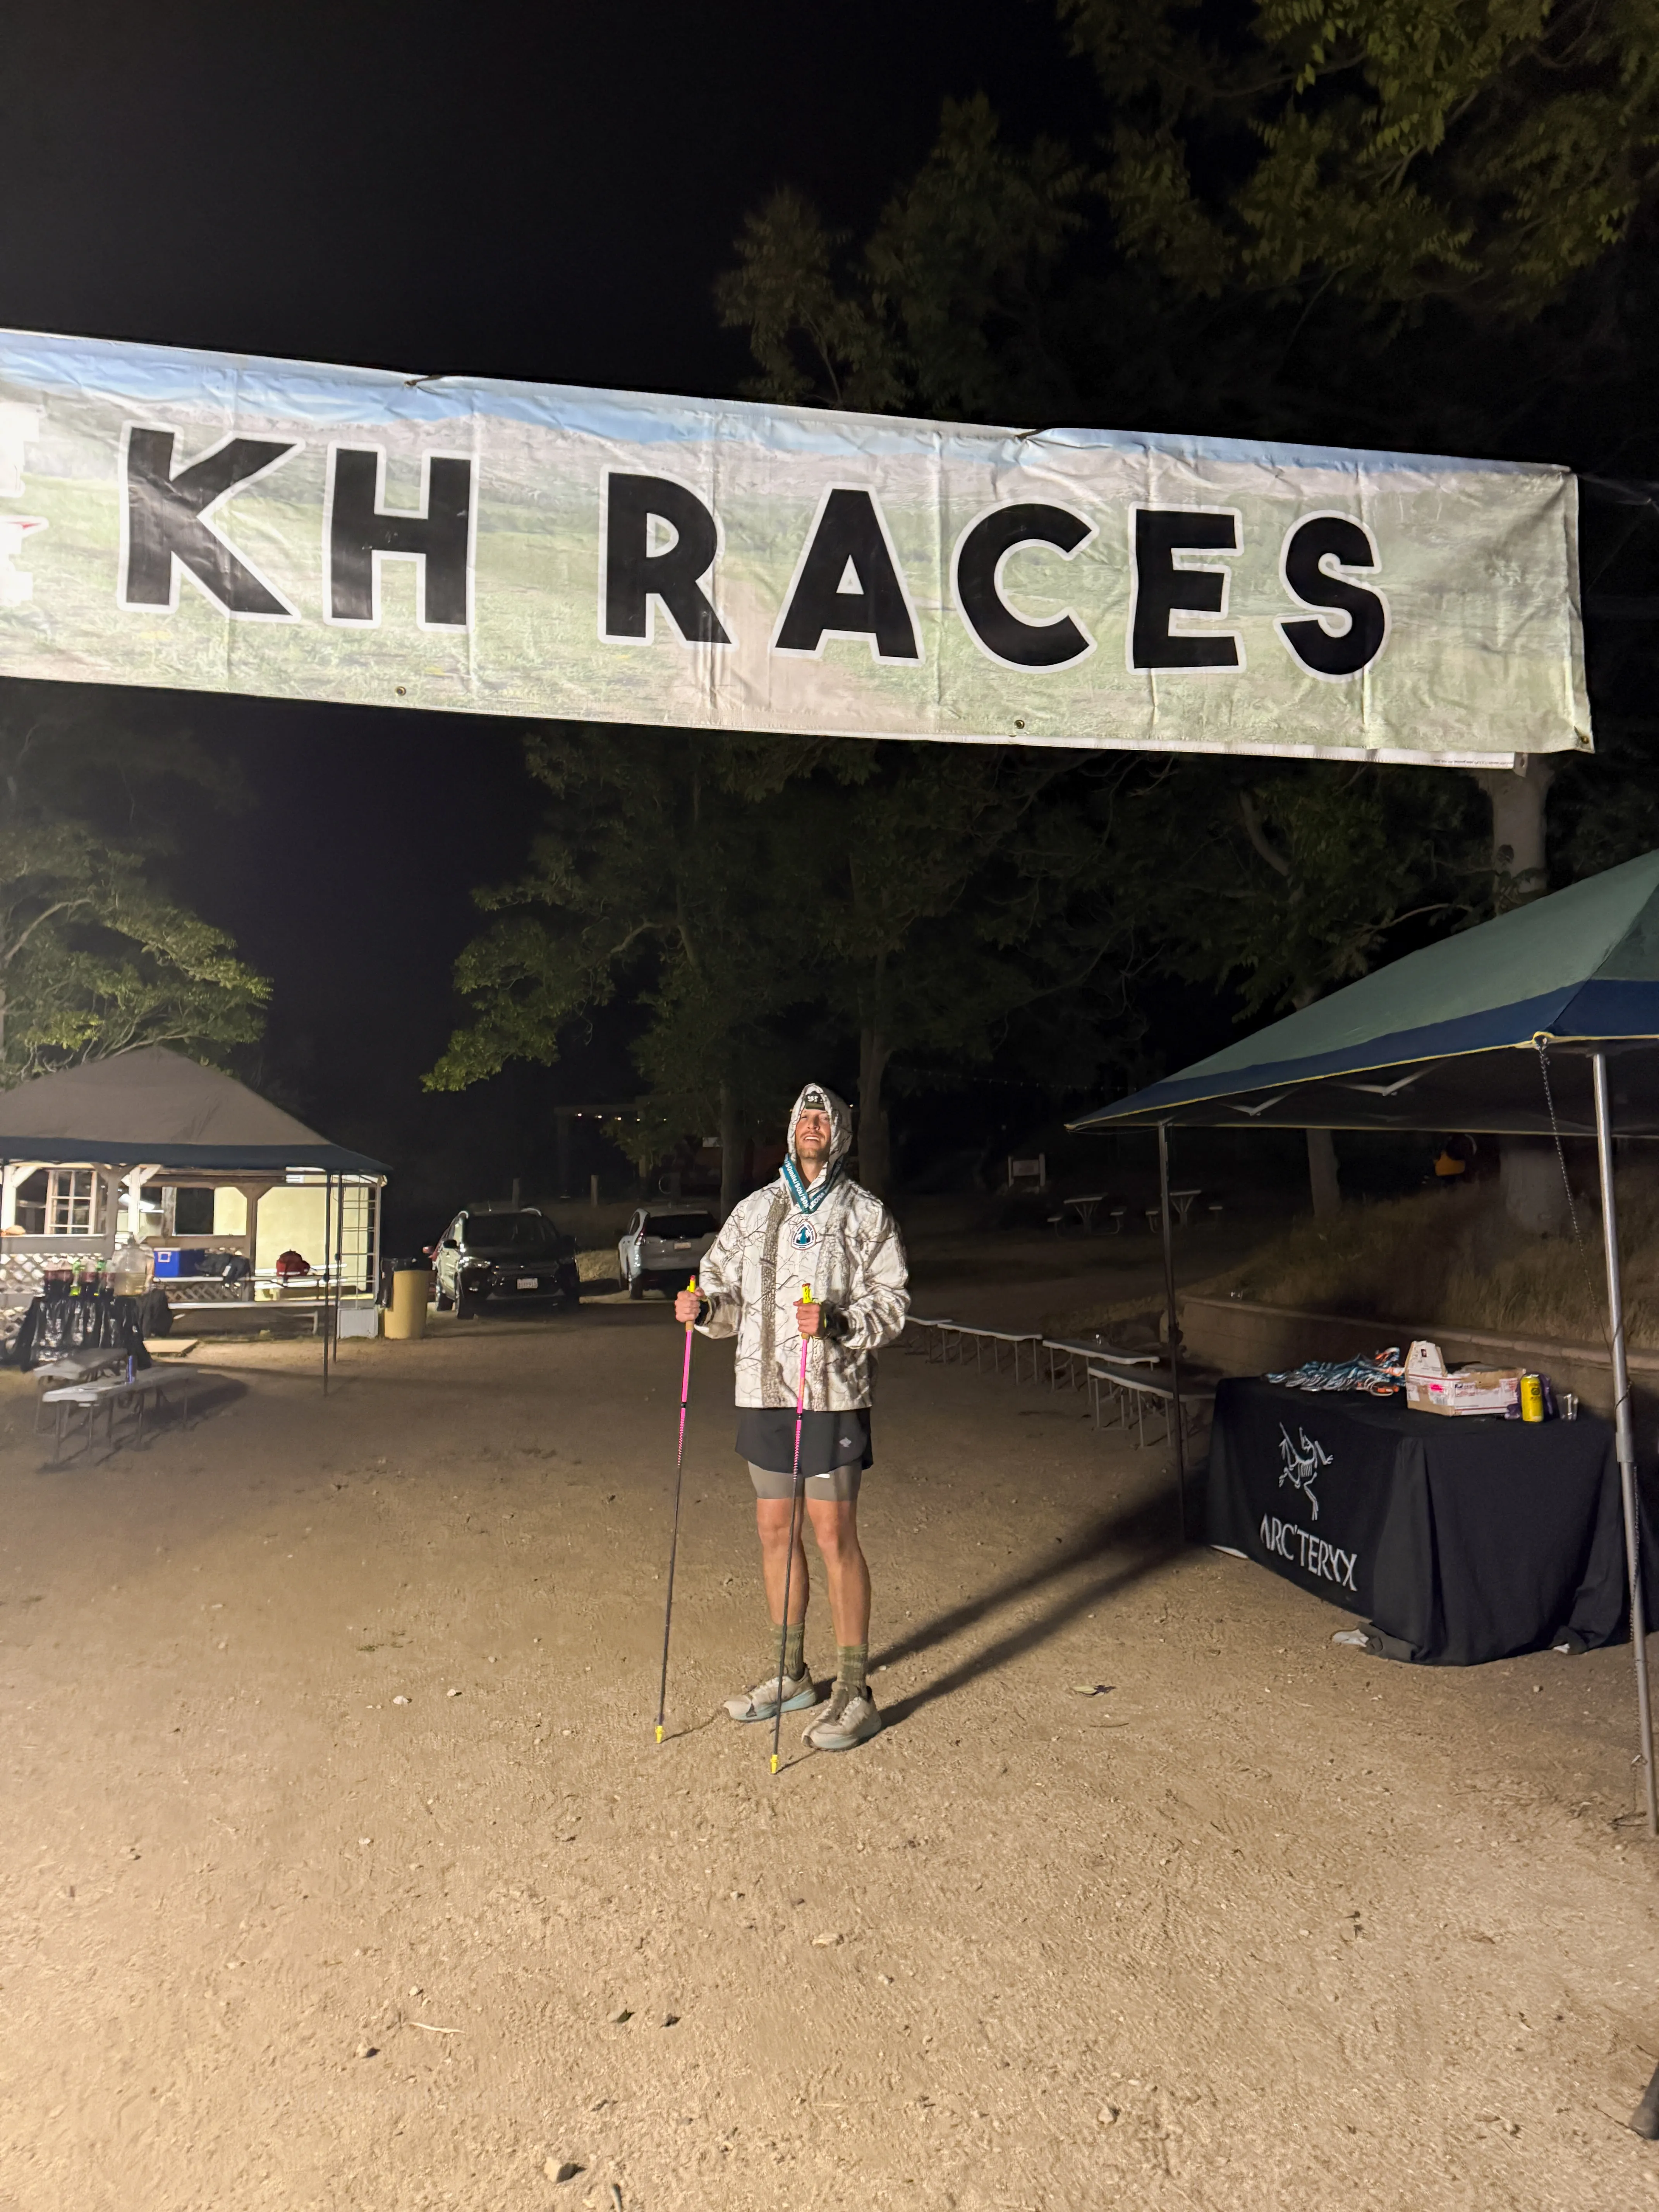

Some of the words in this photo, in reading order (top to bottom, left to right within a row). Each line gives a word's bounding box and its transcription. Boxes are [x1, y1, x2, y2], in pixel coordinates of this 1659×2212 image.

[123, 424, 474, 627] KH
[603, 470, 1387, 676] RACES
[1260, 1513, 1357, 1592] ARC'TERYX
